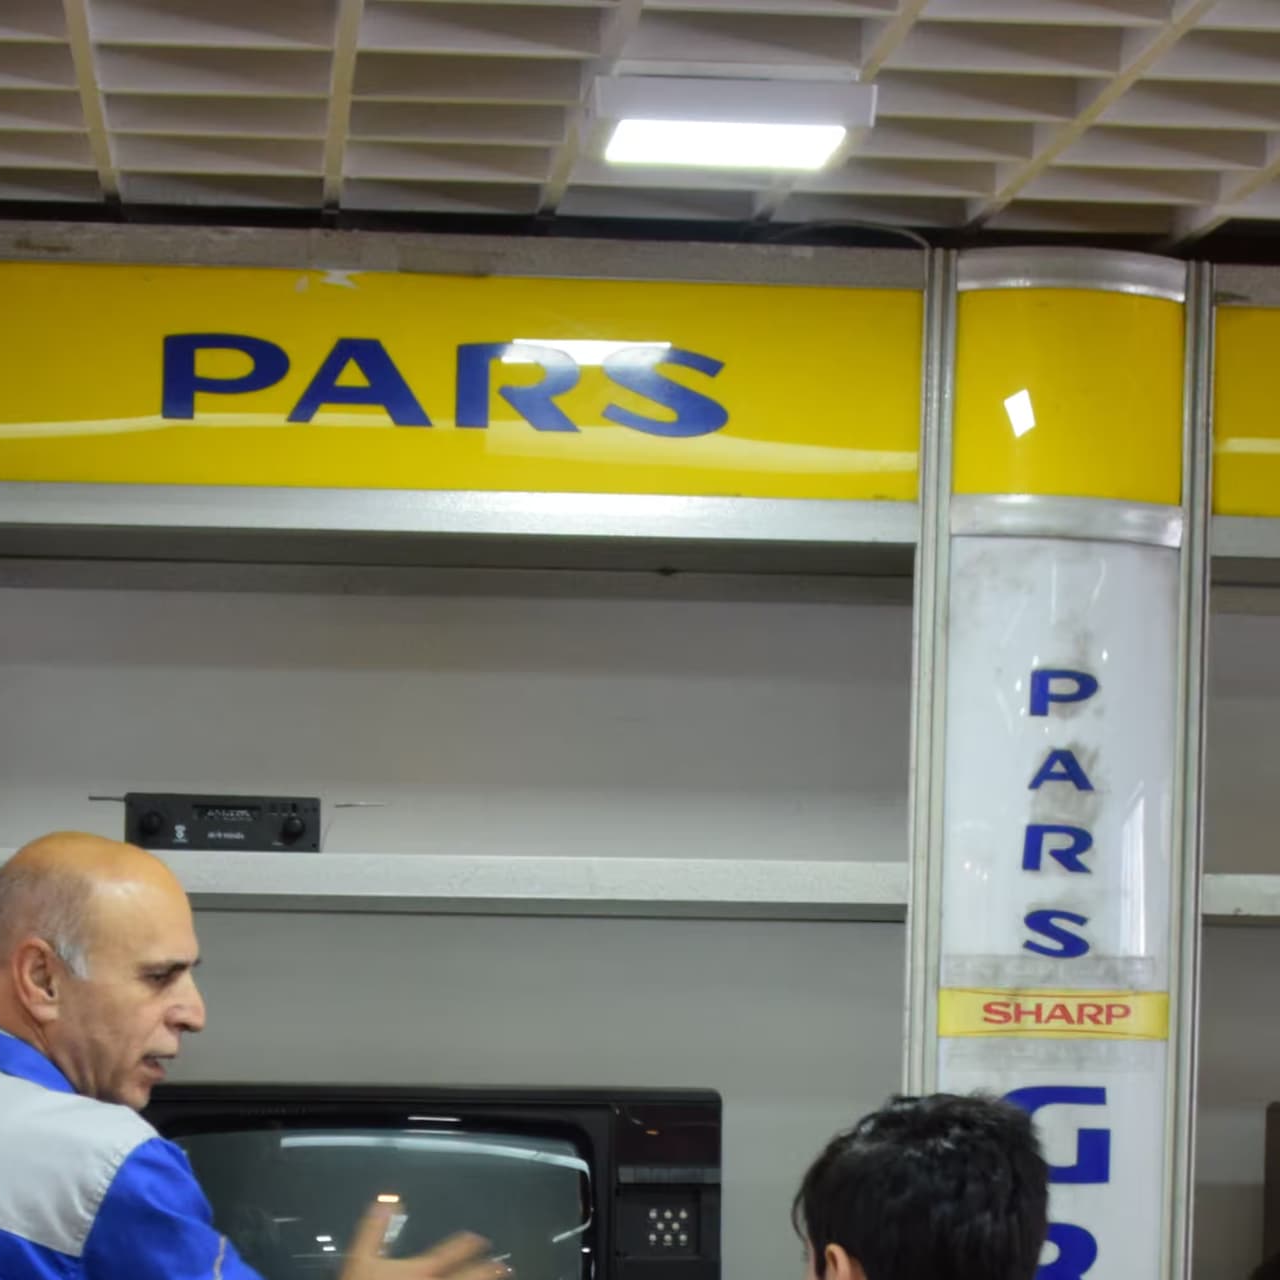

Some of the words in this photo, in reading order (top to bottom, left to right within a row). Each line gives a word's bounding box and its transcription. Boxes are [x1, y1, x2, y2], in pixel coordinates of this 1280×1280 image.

[162, 333, 729, 438] PARS
[1022, 669, 1099, 958] PARS
[982, 1001, 1132, 1026] SHARP
